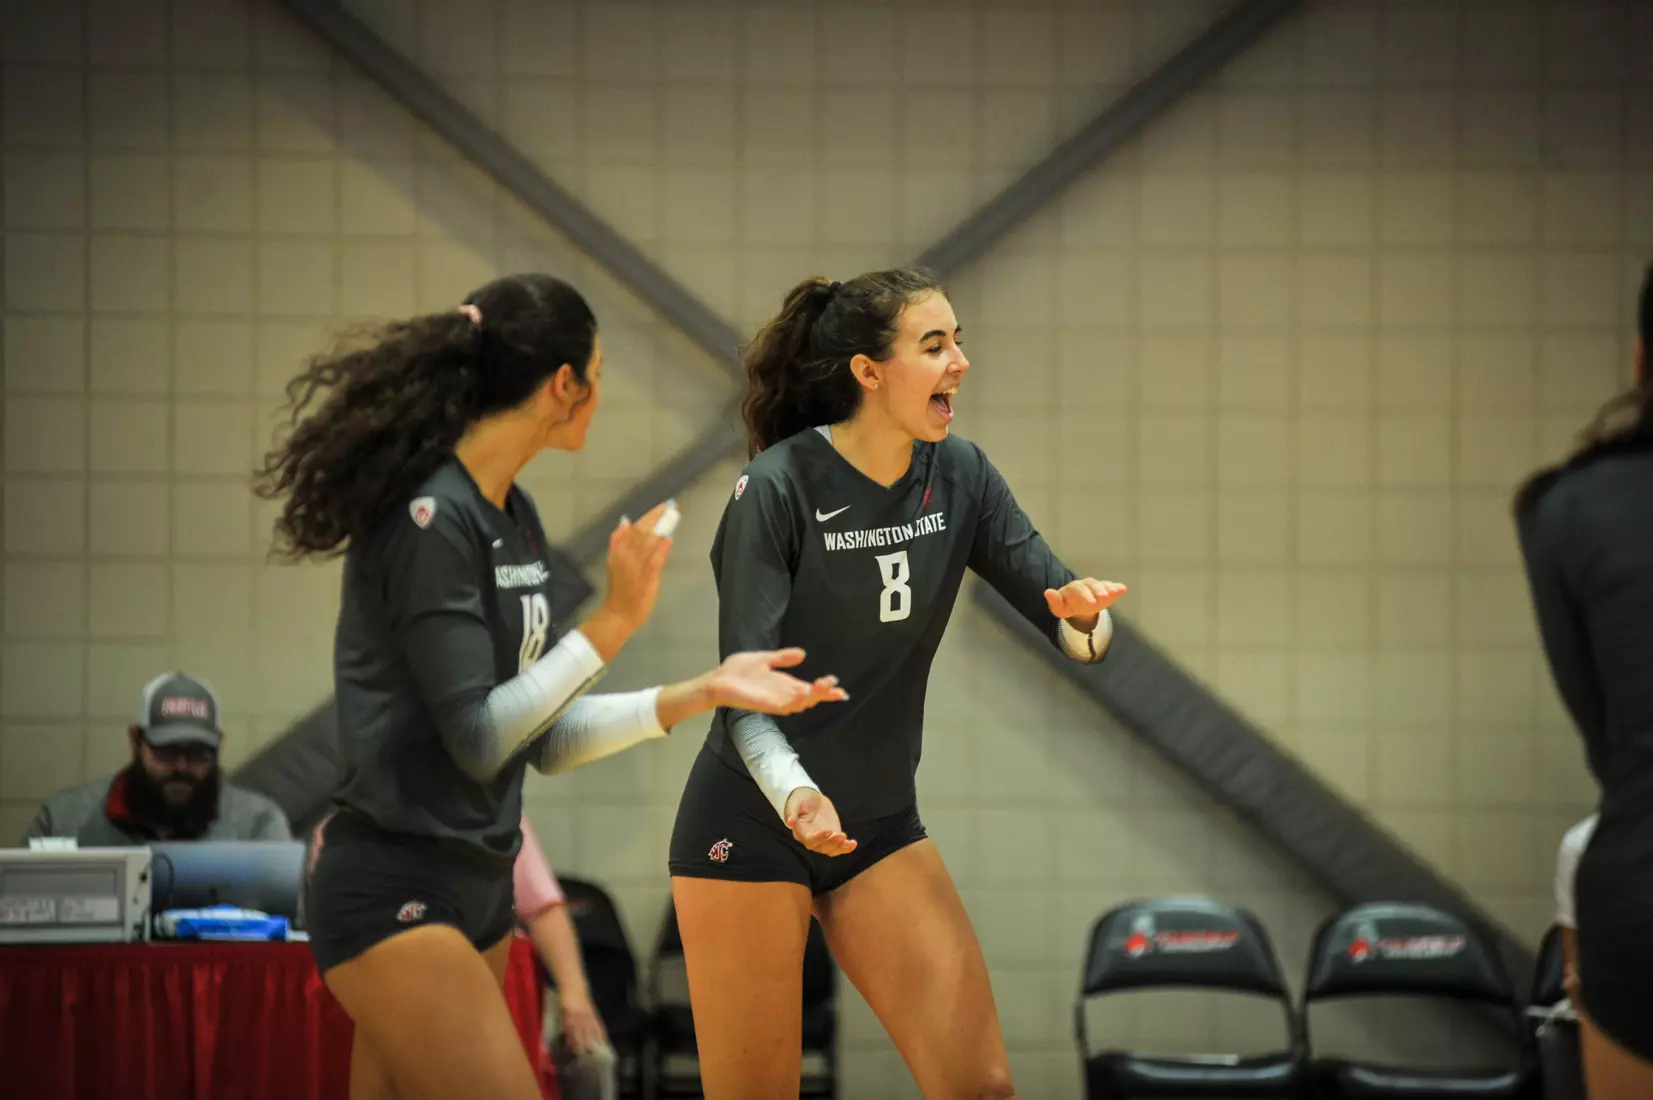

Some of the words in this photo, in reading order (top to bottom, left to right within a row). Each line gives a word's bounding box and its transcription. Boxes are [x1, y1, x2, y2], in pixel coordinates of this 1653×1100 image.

[823, 523, 914, 551] WASHINGTON
[874, 550, 912, 623] 8
[518, 592, 549, 676] 18
